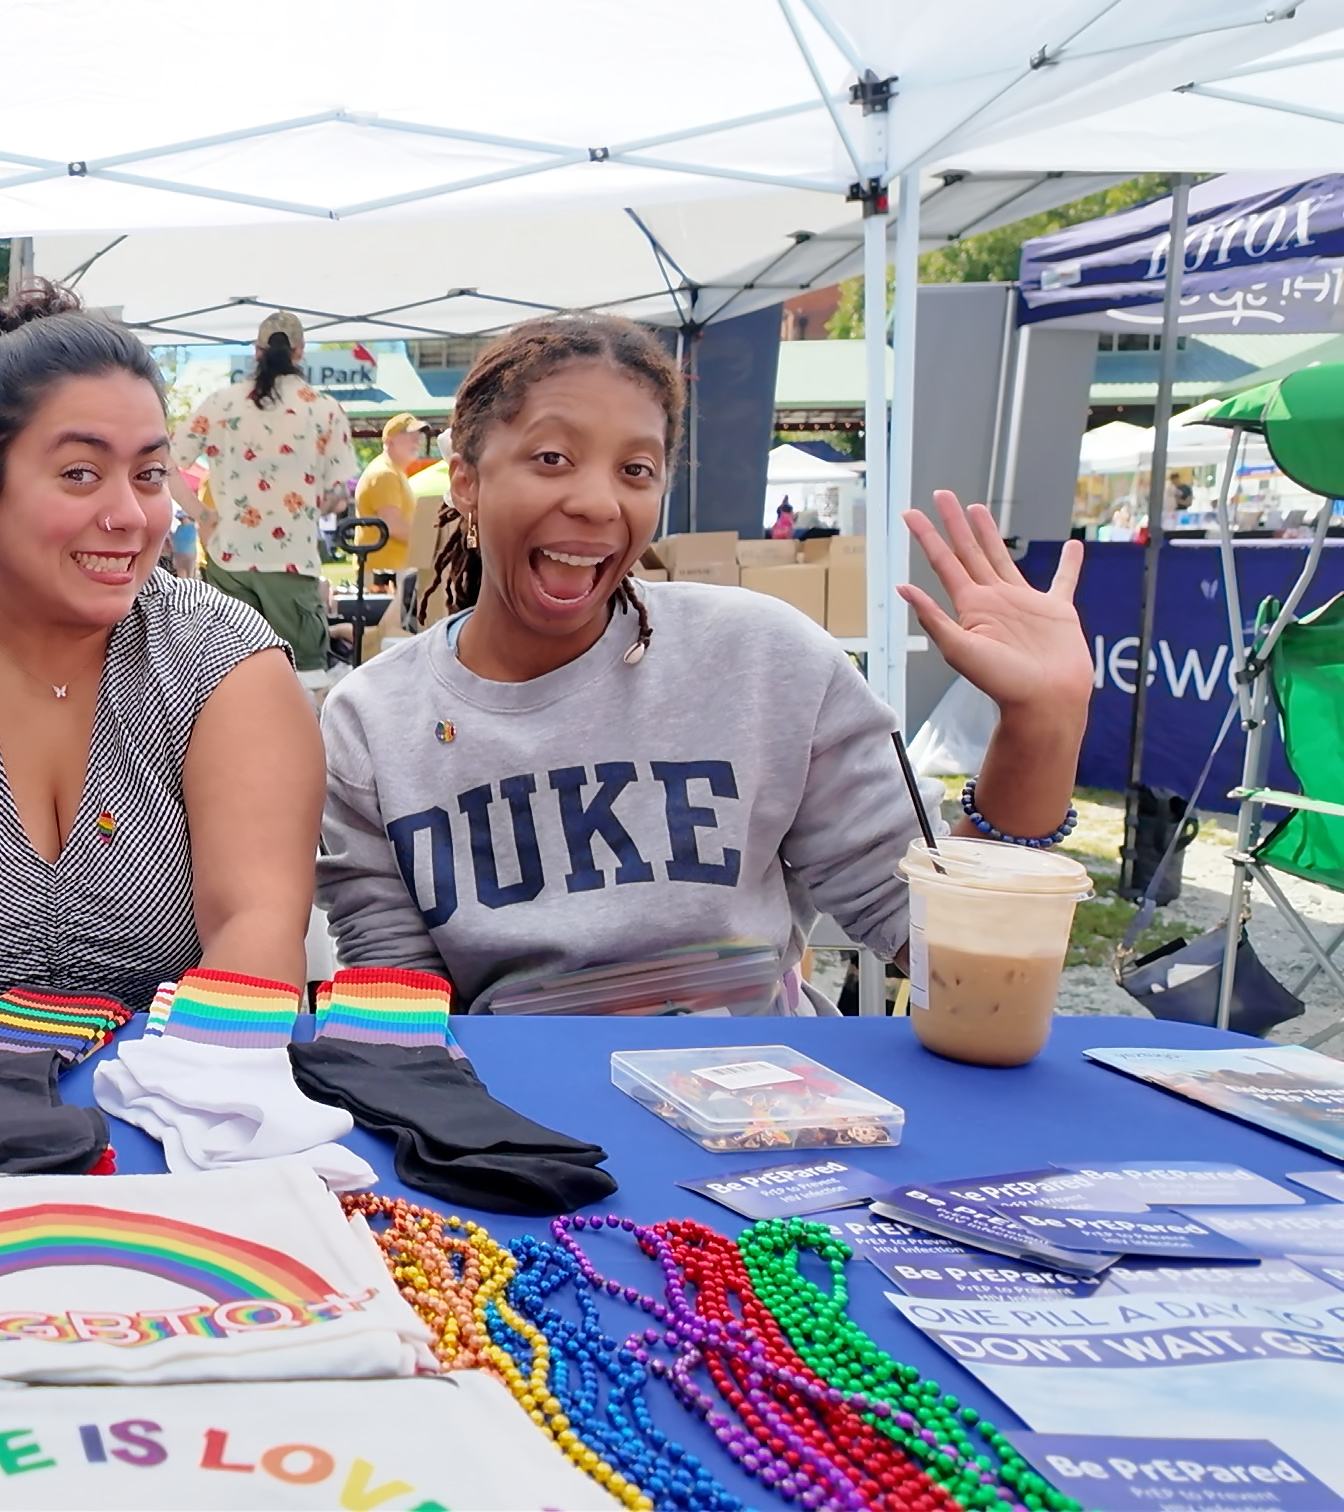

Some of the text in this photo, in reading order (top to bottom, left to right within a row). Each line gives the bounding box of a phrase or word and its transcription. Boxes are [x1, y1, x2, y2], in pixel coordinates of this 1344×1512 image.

[321, 364, 372, 383] Park
[386, 760, 742, 930] DUKE
[706, 1161, 849, 1195] Be PrEPared
[1080, 1169, 1255, 1182] Be PrEPared
[980, 1174, 1095, 1200] PrEPared
[906, 1190, 946, 1206] Be
[1020, 1215, 1209, 1235] Be PrEPared
[855, 1237, 888, 1246] PrEP
[891, 1238, 908, 1247] to
[873, 1245, 965, 1255] HIV Infection
[894, 1265, 943, 1281] Be
[1109, 1267, 1315, 1284] Be PrEPared
[956, 1284, 990, 1293] PrEP
[908, 1303, 1002, 1328] ONE
[1008, 1308, 1110, 1330] PILL
[1117, 1302, 1156, 1324] A
[1157, 1300, 1249, 1321] DAY
[1253, 1305, 1325, 1331] TO
[938, 1333, 1103, 1364] DON'T
[1103, 1329, 1267, 1361] WAIT,
[79, 1418, 168, 1467] IS
[199, 1427, 452, 1512] LOV
[1045, 1454, 1306, 1484] Be PrEPared
